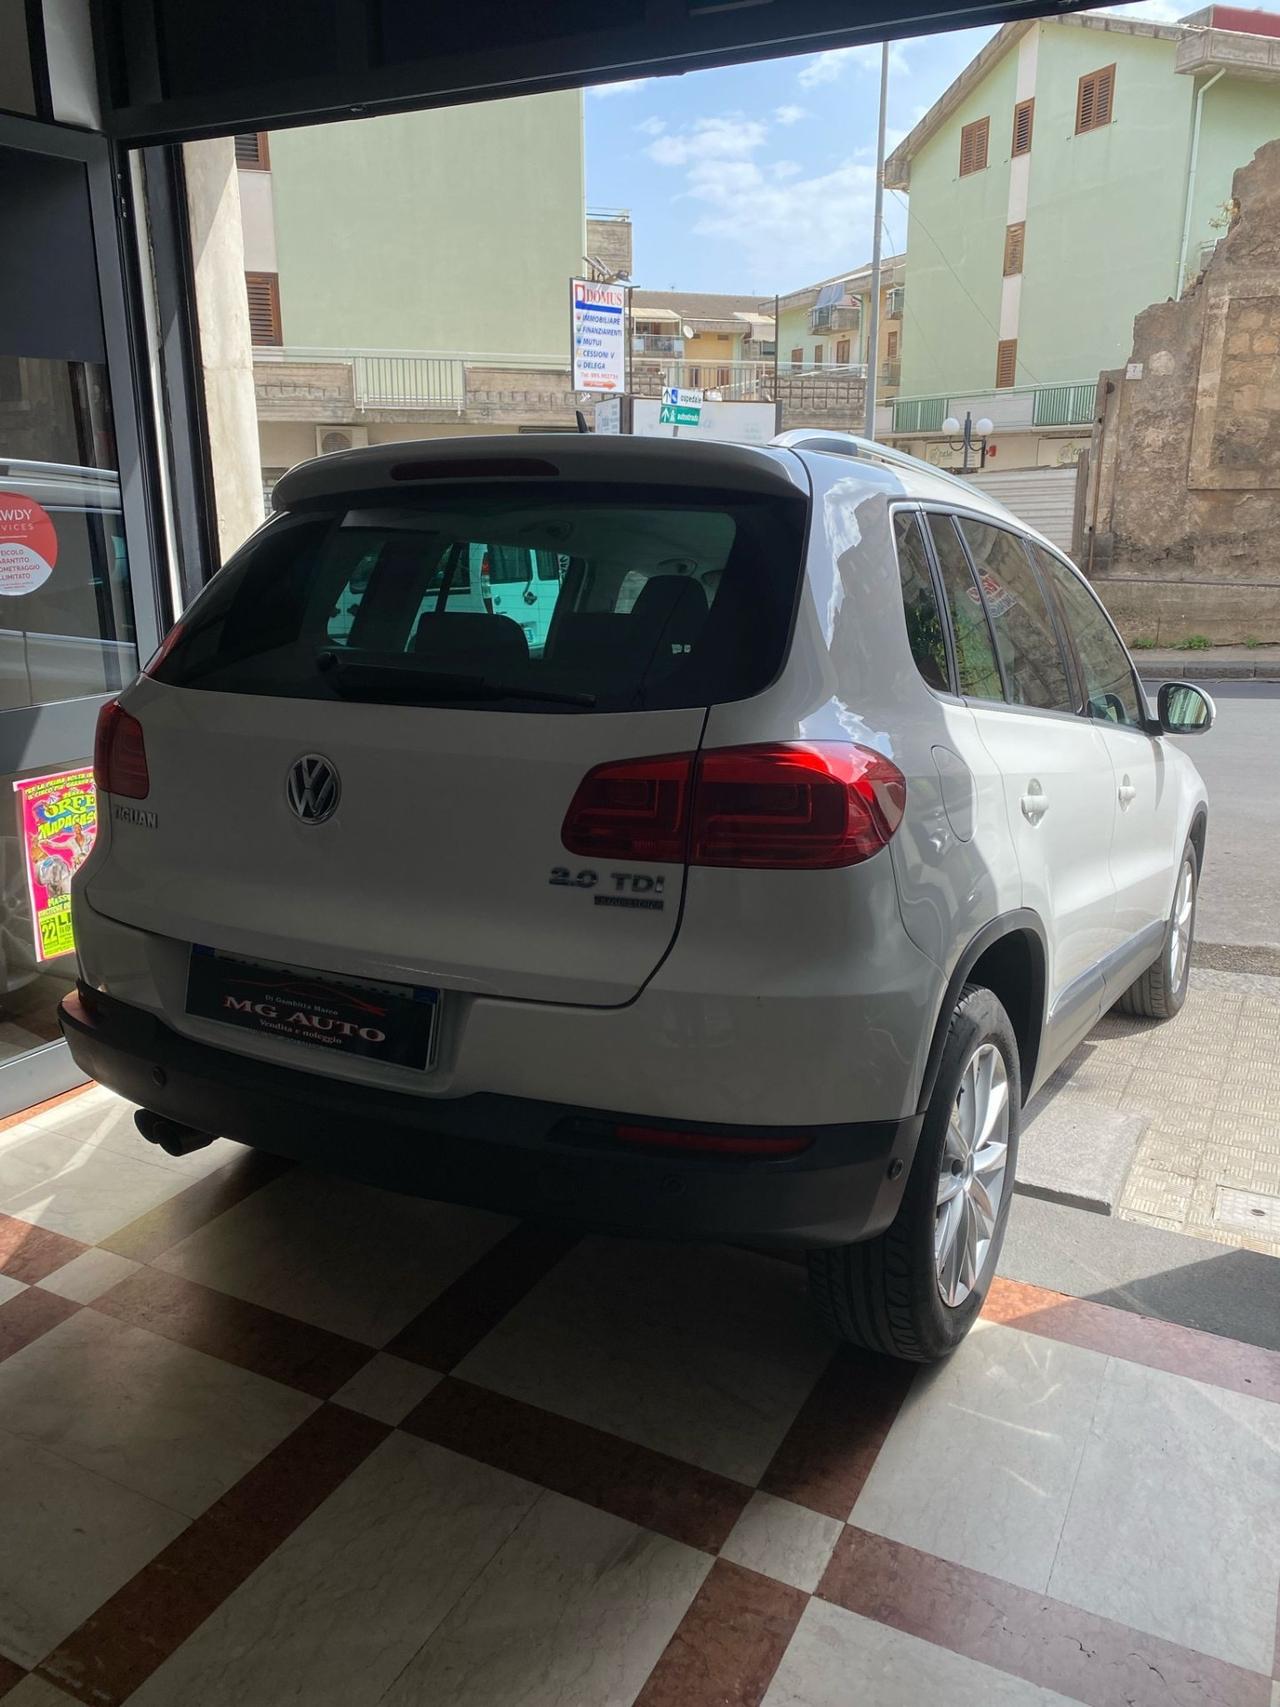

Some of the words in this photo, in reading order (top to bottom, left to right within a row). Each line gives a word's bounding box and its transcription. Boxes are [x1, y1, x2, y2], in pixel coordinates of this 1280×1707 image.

[586, 288, 622, 306] DOMUS
[583, 314, 621, 325] IMMOBILIARE
[583, 326, 622, 337] FINANZIAMENTI
[583, 338, 602, 347] MUTUI
[583, 350, 609, 359] CESSIONI
[583, 361, 606, 369] DELEGA
[0, 508, 33, 521] WDY
[548, 866, 599, 888] 2.0
[223, 995, 277, 1018] MG
[287, 1011, 387, 1043] AUTO
[259, 1018, 294, 1035] Vendita
